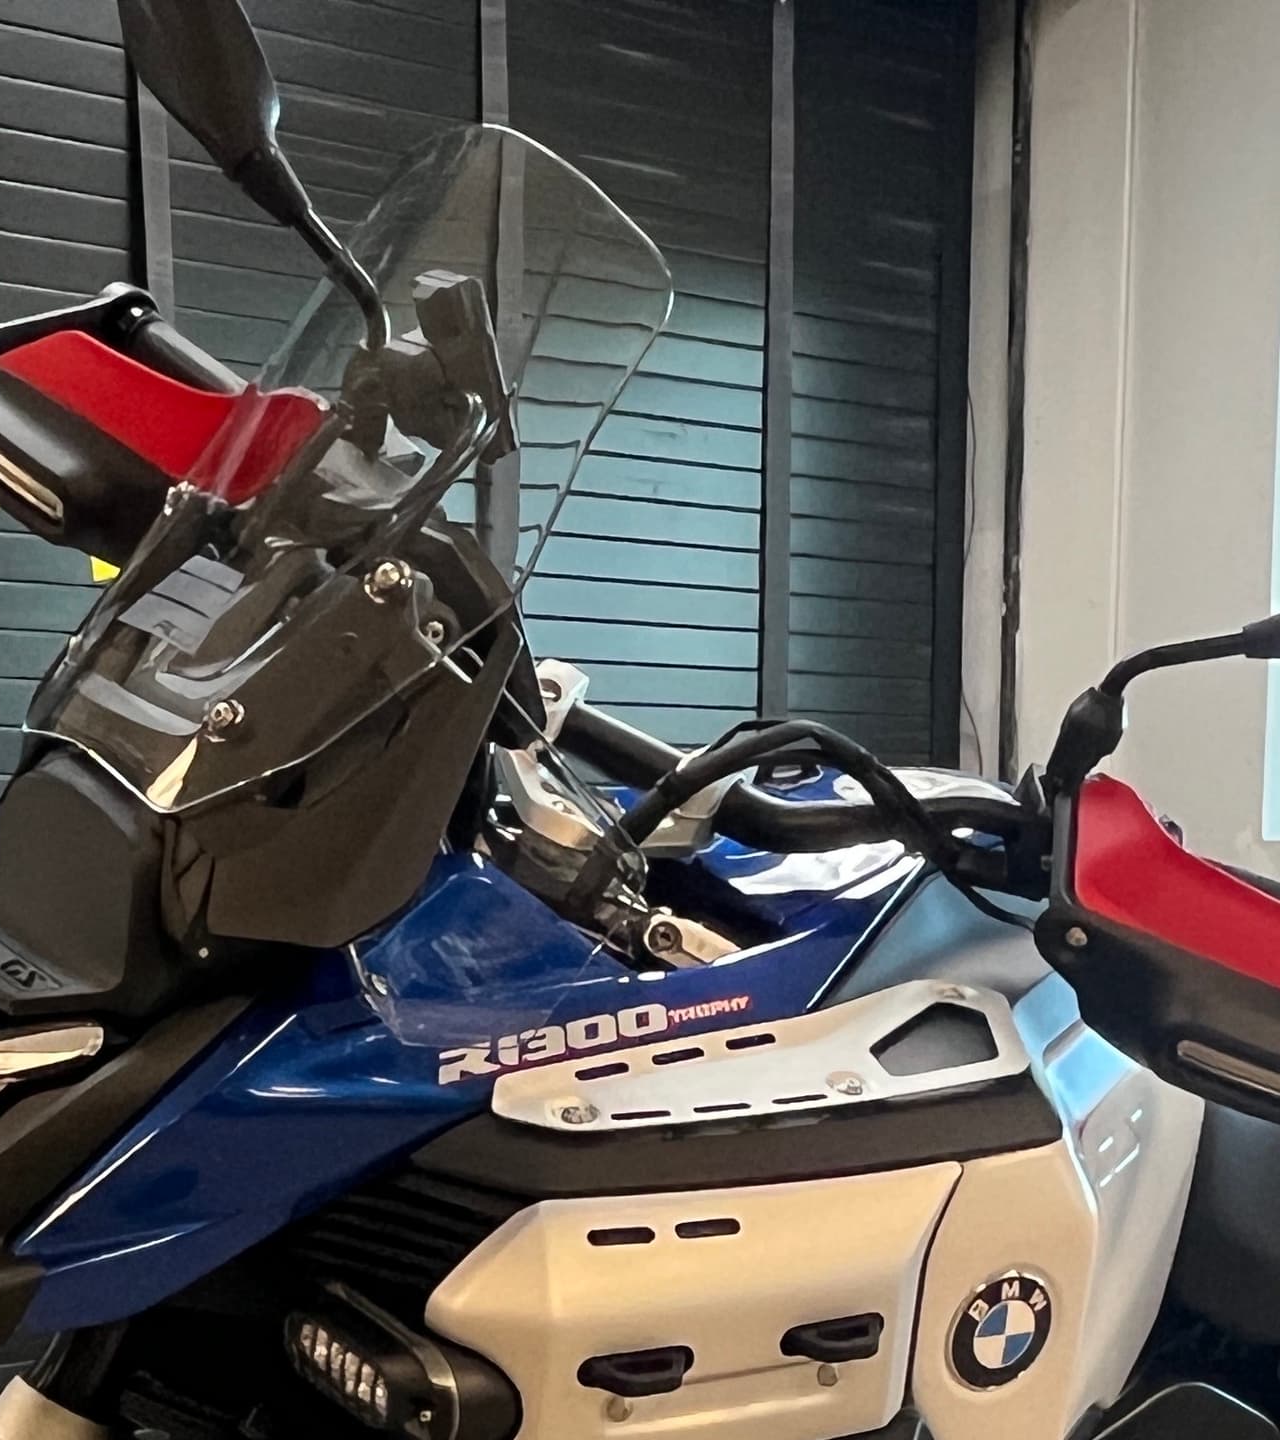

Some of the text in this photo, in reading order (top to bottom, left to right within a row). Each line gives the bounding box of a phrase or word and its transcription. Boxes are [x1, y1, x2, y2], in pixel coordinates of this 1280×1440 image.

[0, 959, 46, 987] GS
[668, 996, 749, 1023] TROPHY
[968, 1280, 1047, 1321] BMW
